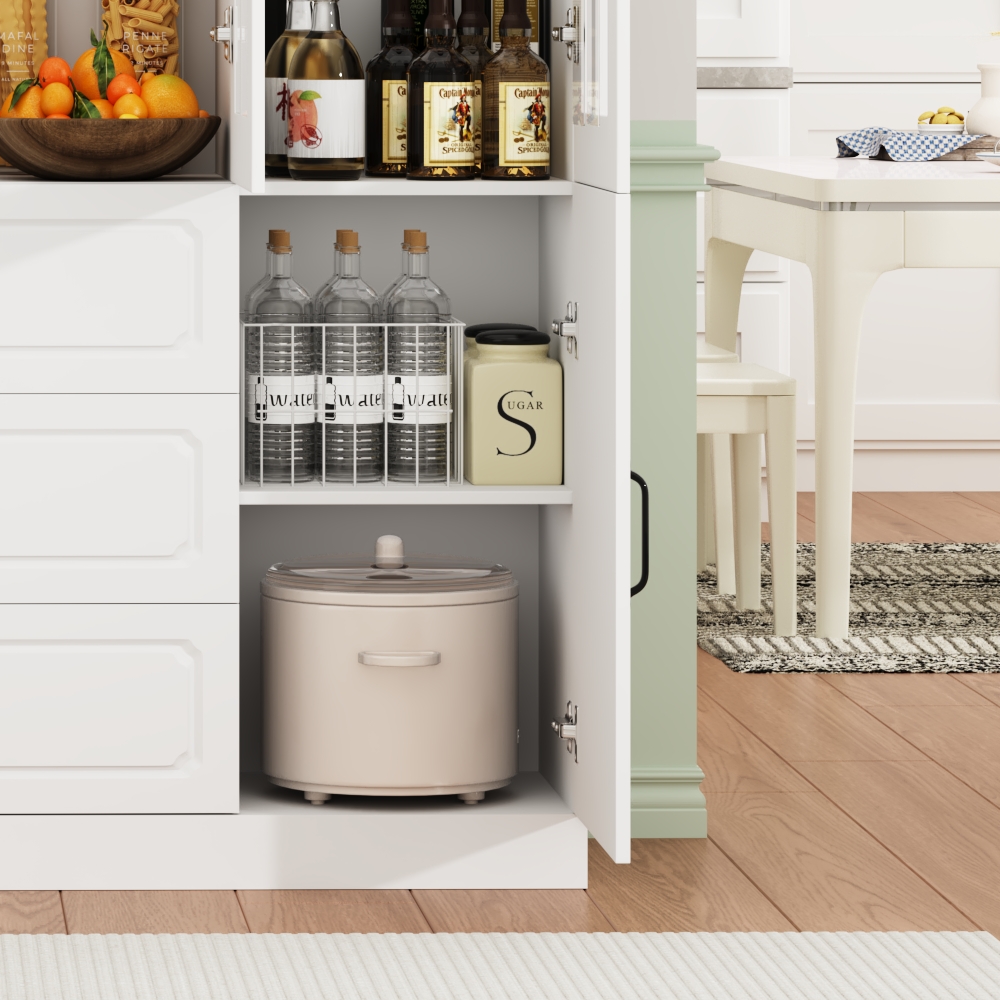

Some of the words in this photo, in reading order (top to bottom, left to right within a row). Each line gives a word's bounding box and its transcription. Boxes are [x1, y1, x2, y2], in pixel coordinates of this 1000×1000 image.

[123, 32, 167, 41] PENNE
[2, 44, 34, 54] DINE
[122, 44, 168, 54] RIGATE
[439, 88, 462, 99] Captain
[514, 88, 538, 99] Captain
